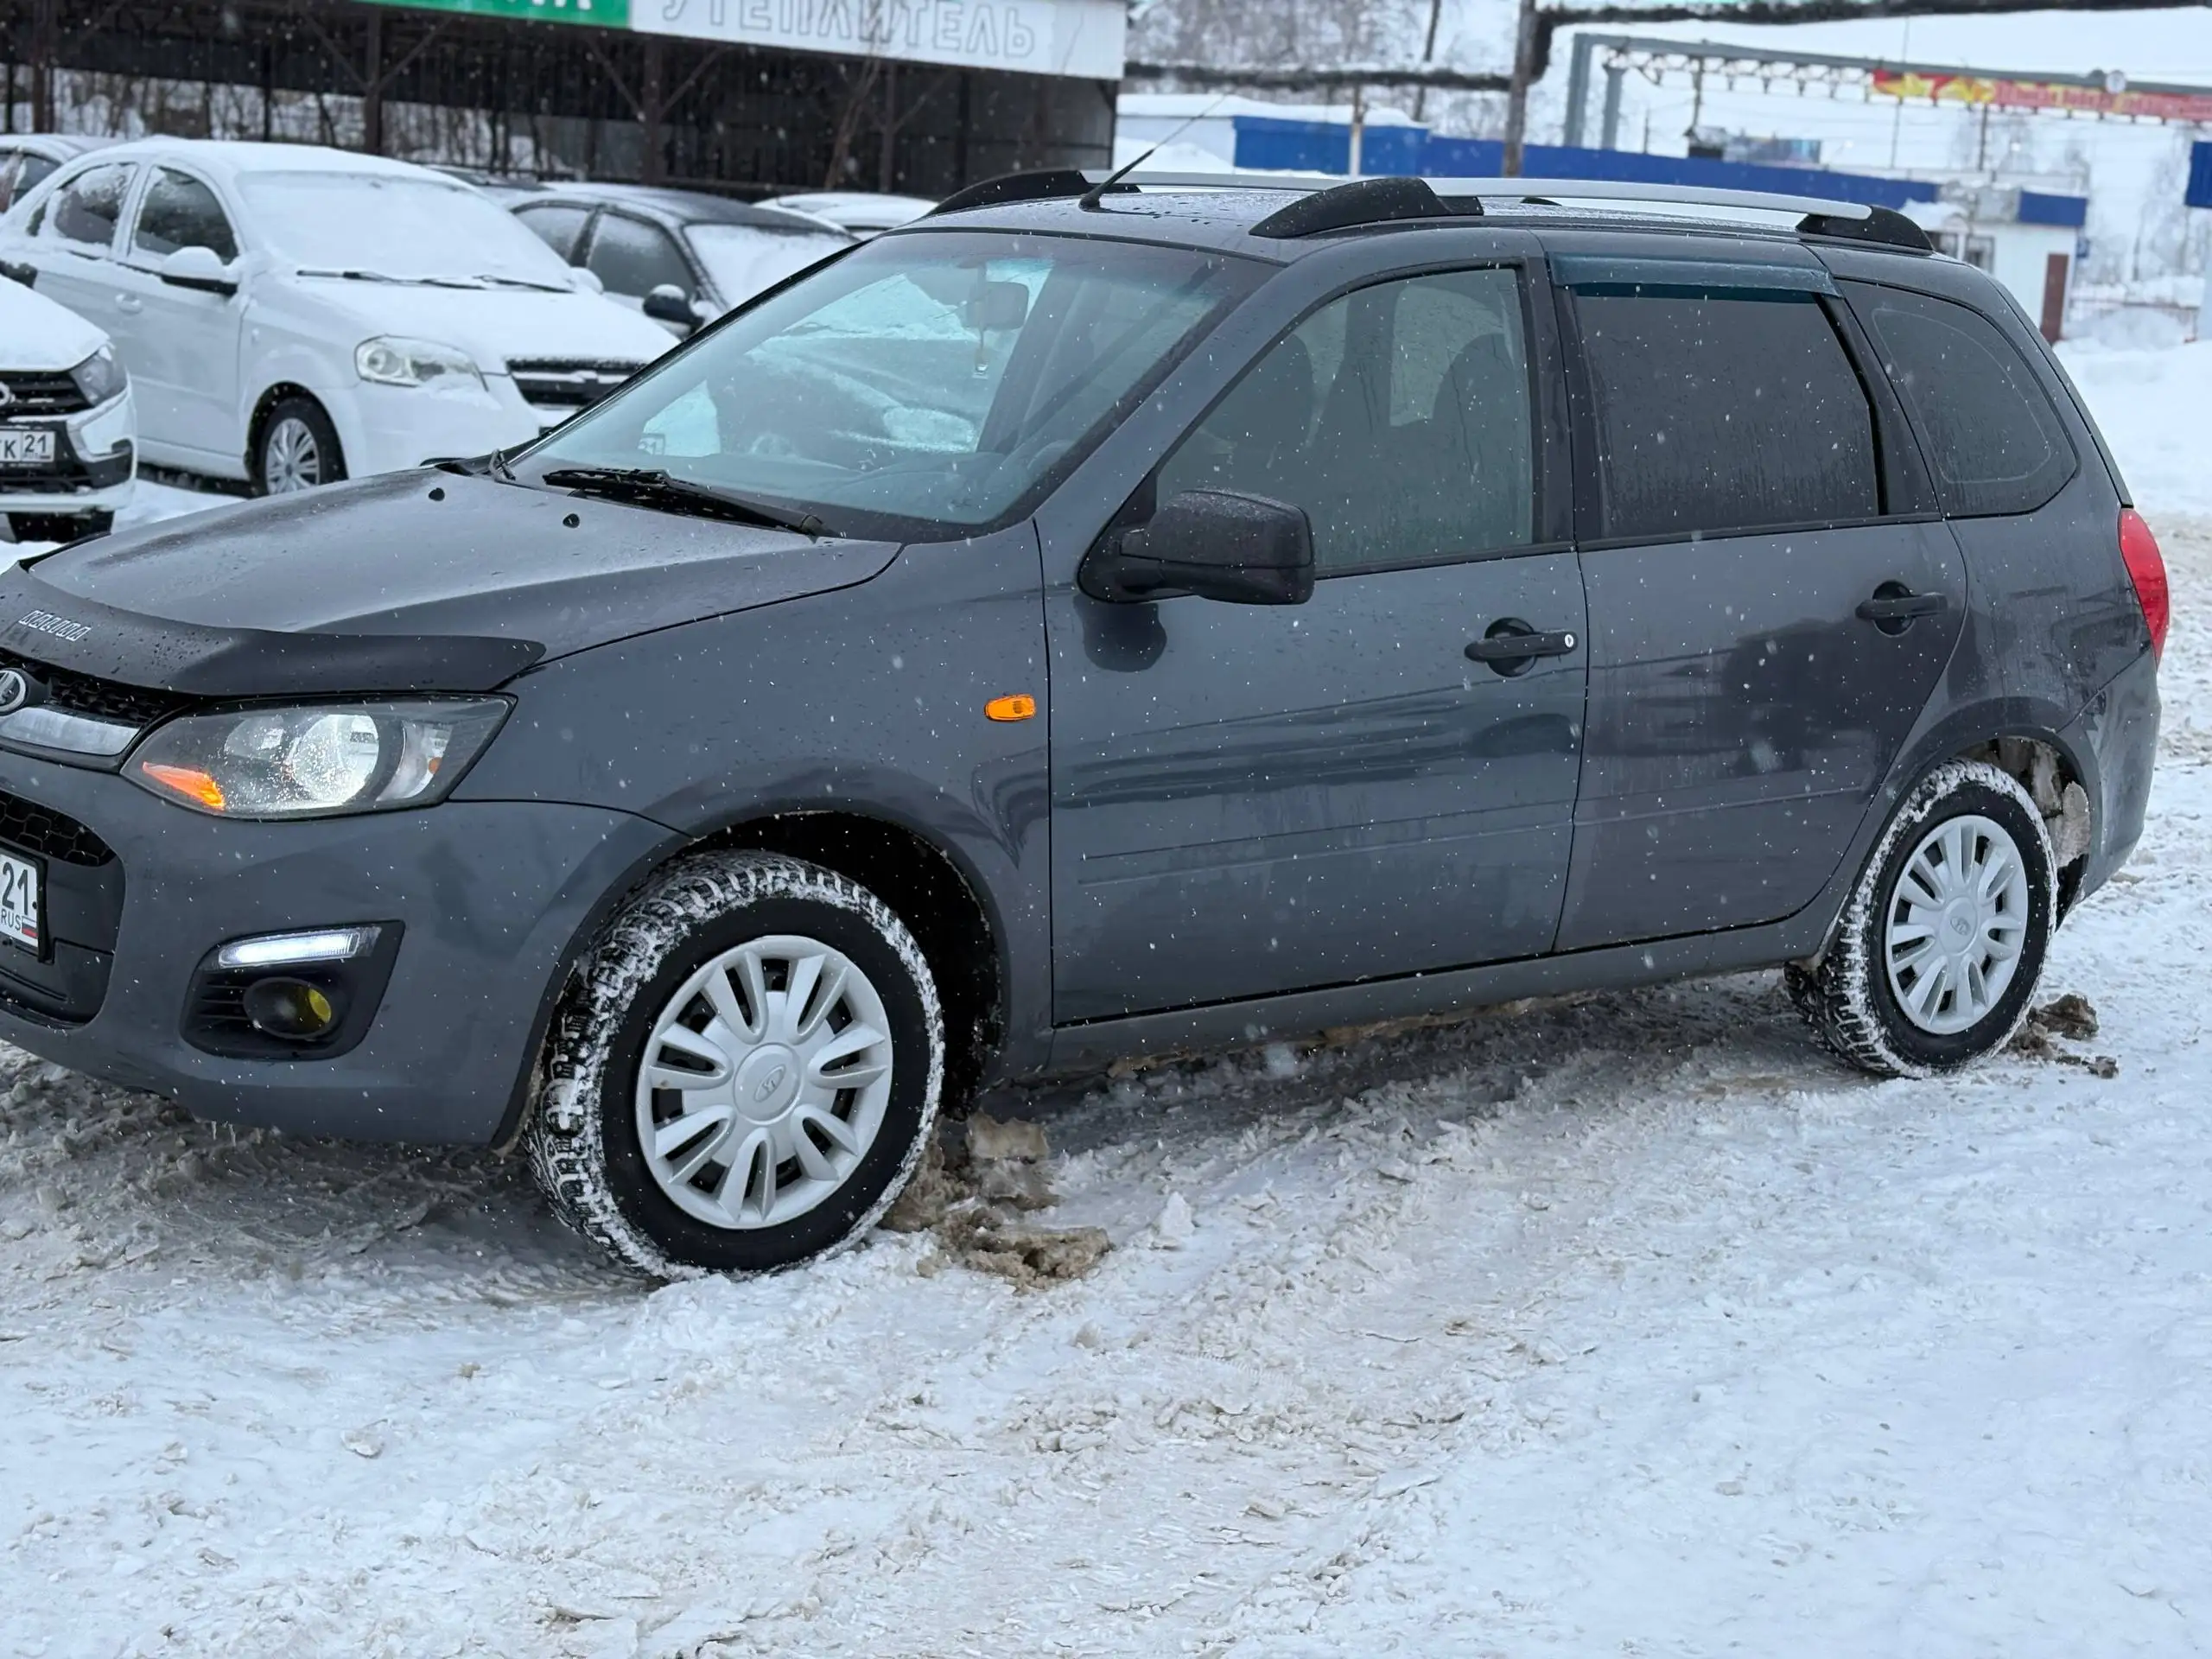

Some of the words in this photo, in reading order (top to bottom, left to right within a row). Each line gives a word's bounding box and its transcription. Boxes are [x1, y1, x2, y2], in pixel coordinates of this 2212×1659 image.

[24, 434, 47, 454] 21
[2, 861, 29, 916] 21
[1, 908, 22, 931] RUS
